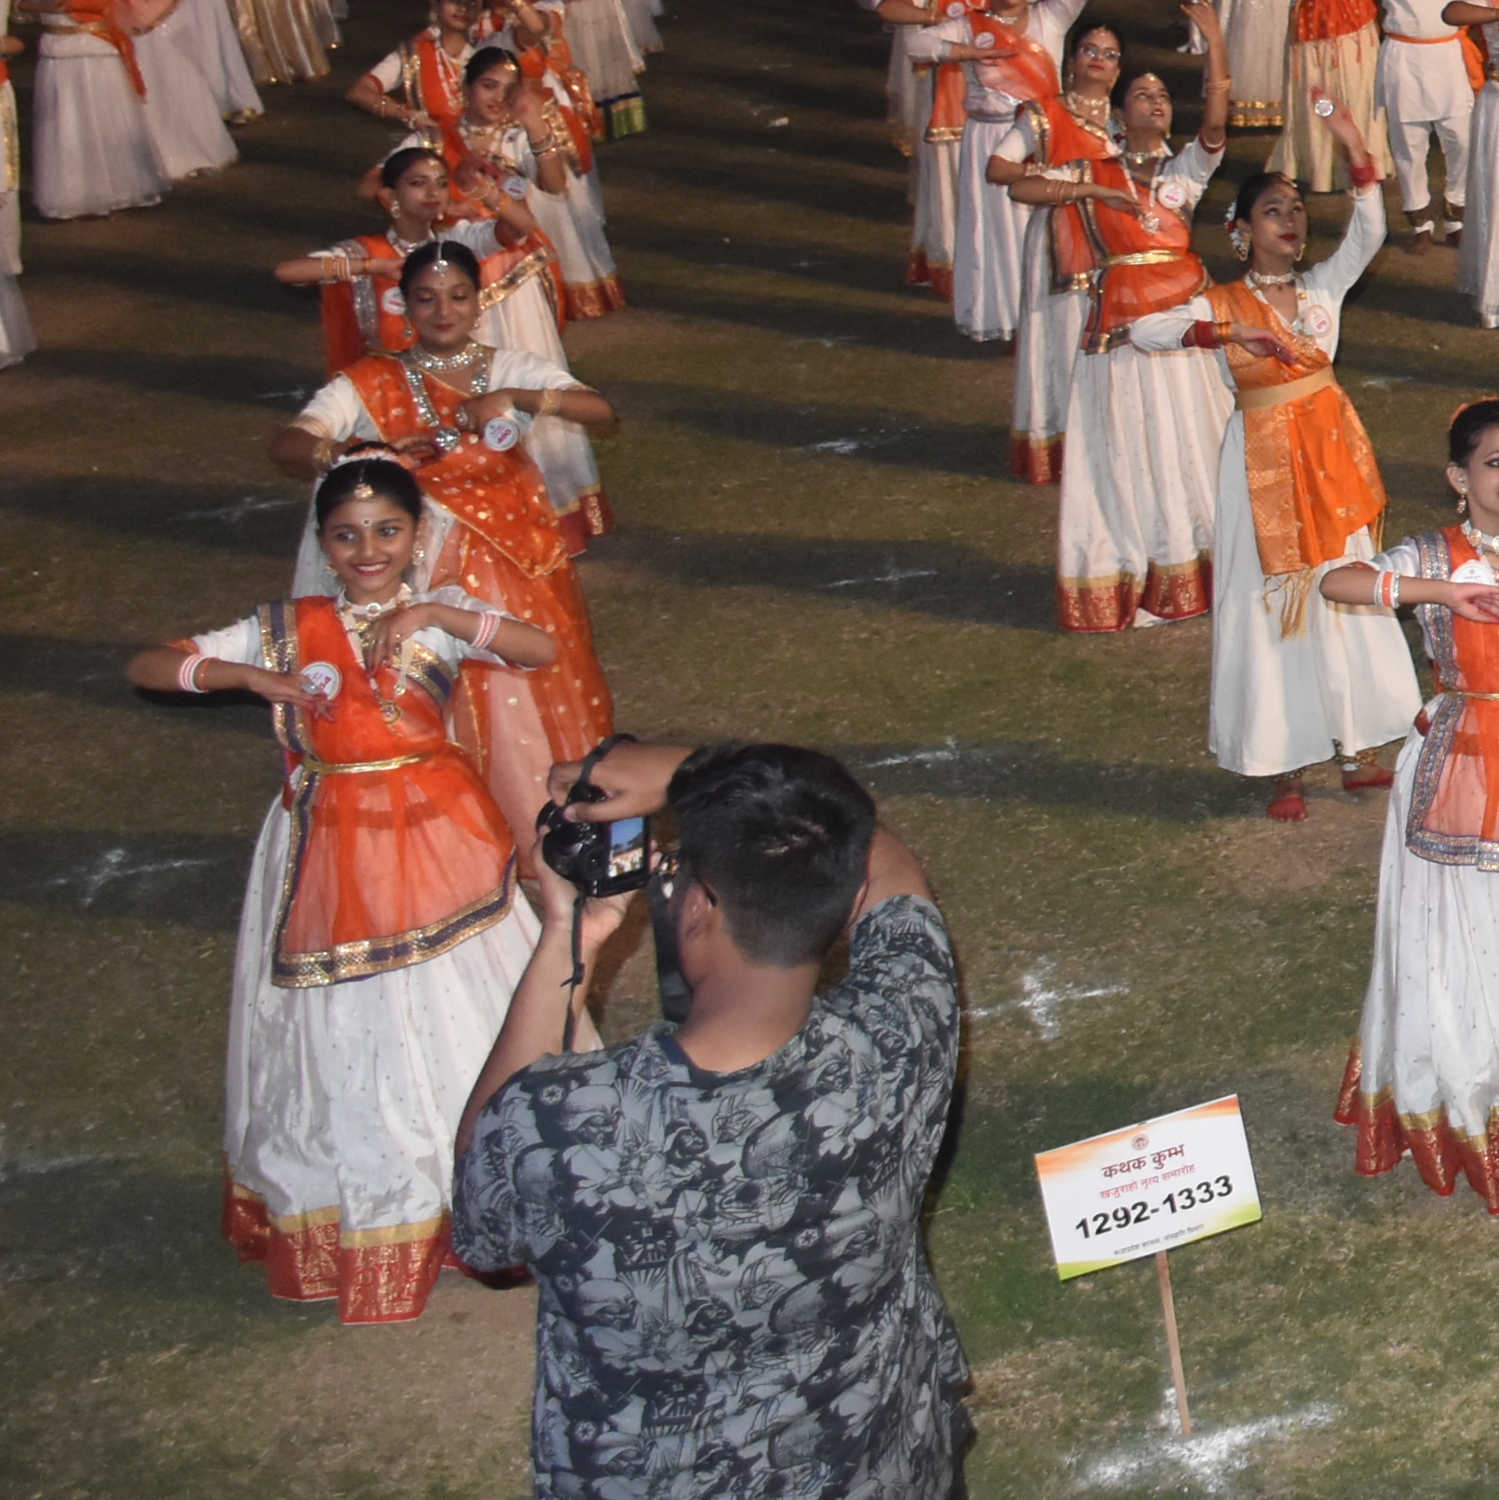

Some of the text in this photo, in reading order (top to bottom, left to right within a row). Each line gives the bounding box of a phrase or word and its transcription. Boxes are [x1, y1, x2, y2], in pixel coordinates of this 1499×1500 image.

[1101, 1144, 1185, 1180] कथक कुम्भ
[1100, 1163, 1195, 1199] खजुराहो नृत्य समारोह
[1075, 1174, 1233, 1239] 1292-1333
